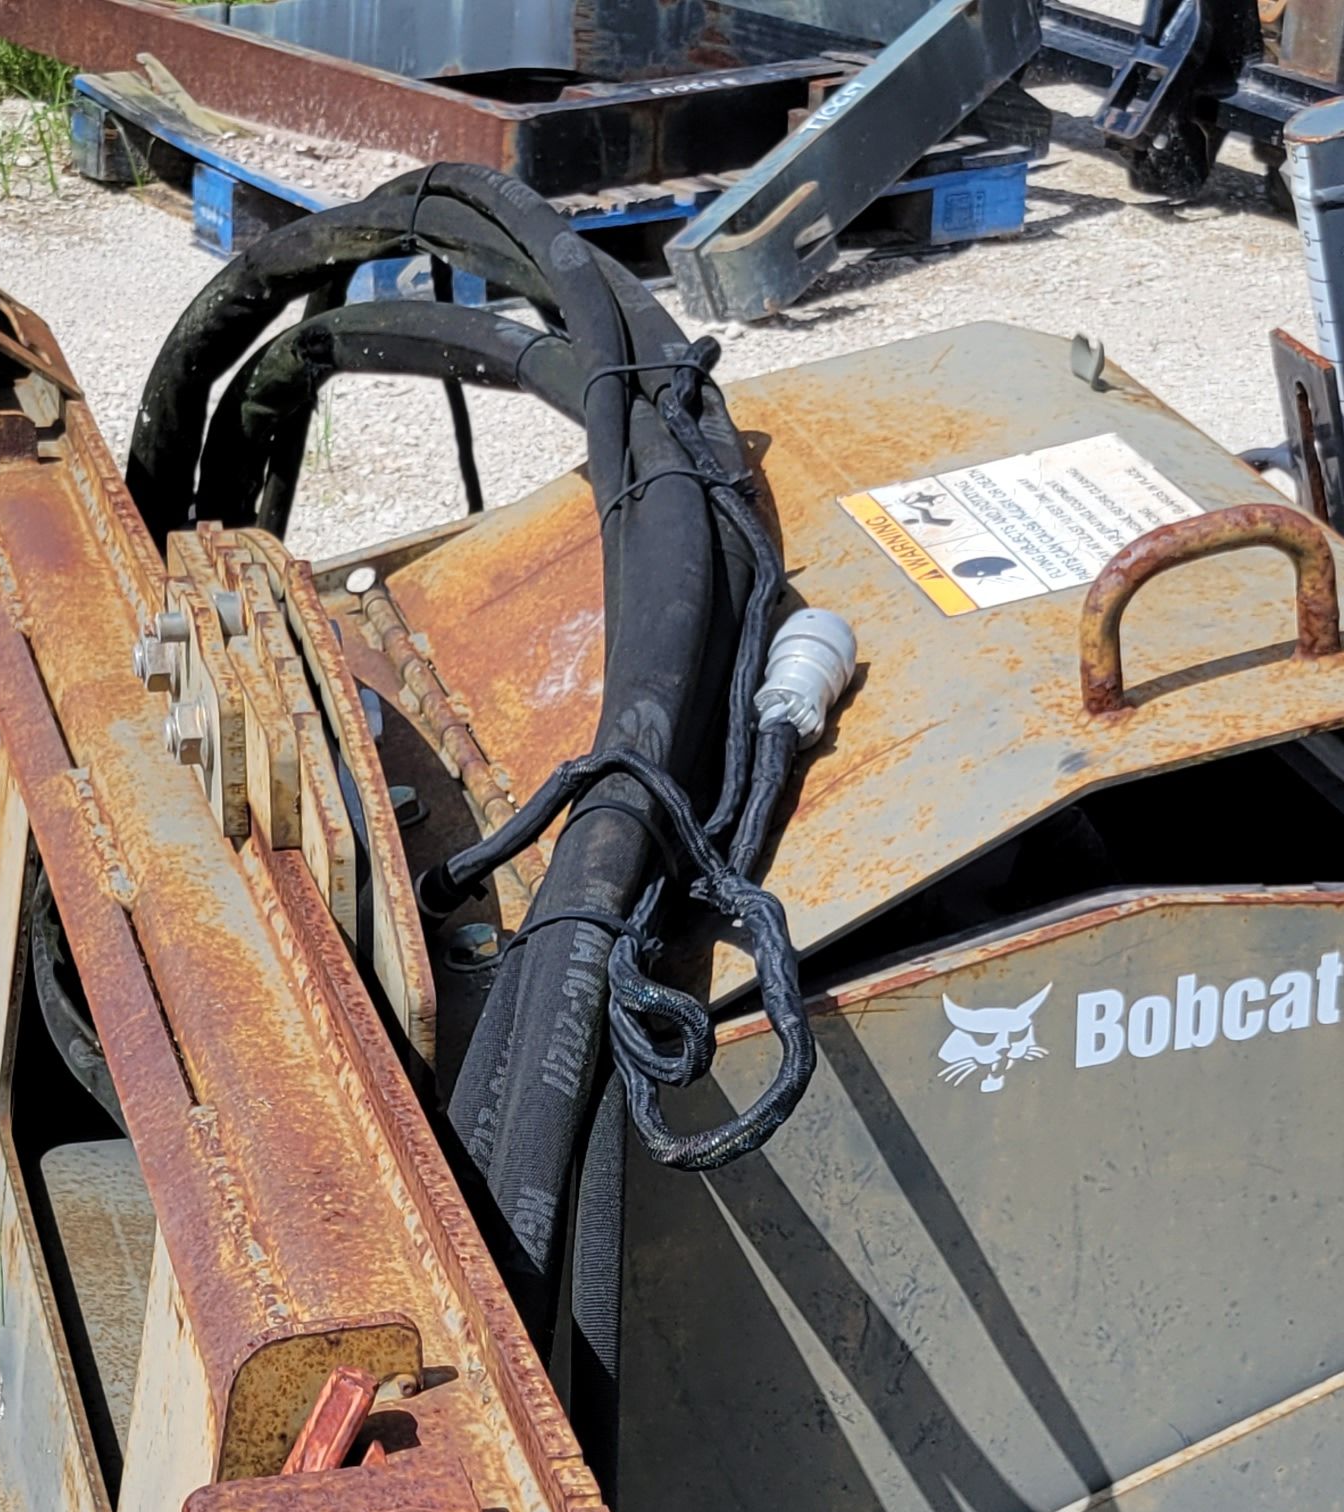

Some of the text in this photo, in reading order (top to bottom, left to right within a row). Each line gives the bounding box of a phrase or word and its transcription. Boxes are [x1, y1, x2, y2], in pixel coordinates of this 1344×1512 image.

[1304, 232, 1311, 246] 5
[862, 515, 931, 570] WARNING
[952, 480, 1066, 578] FLYING OBJECTS AND ROTATING
[964, 468, 1093, 580] PARTS CAN CAUSE INJURY OR DEATH
[1076, 951, 1344, 1068] Bobcat
